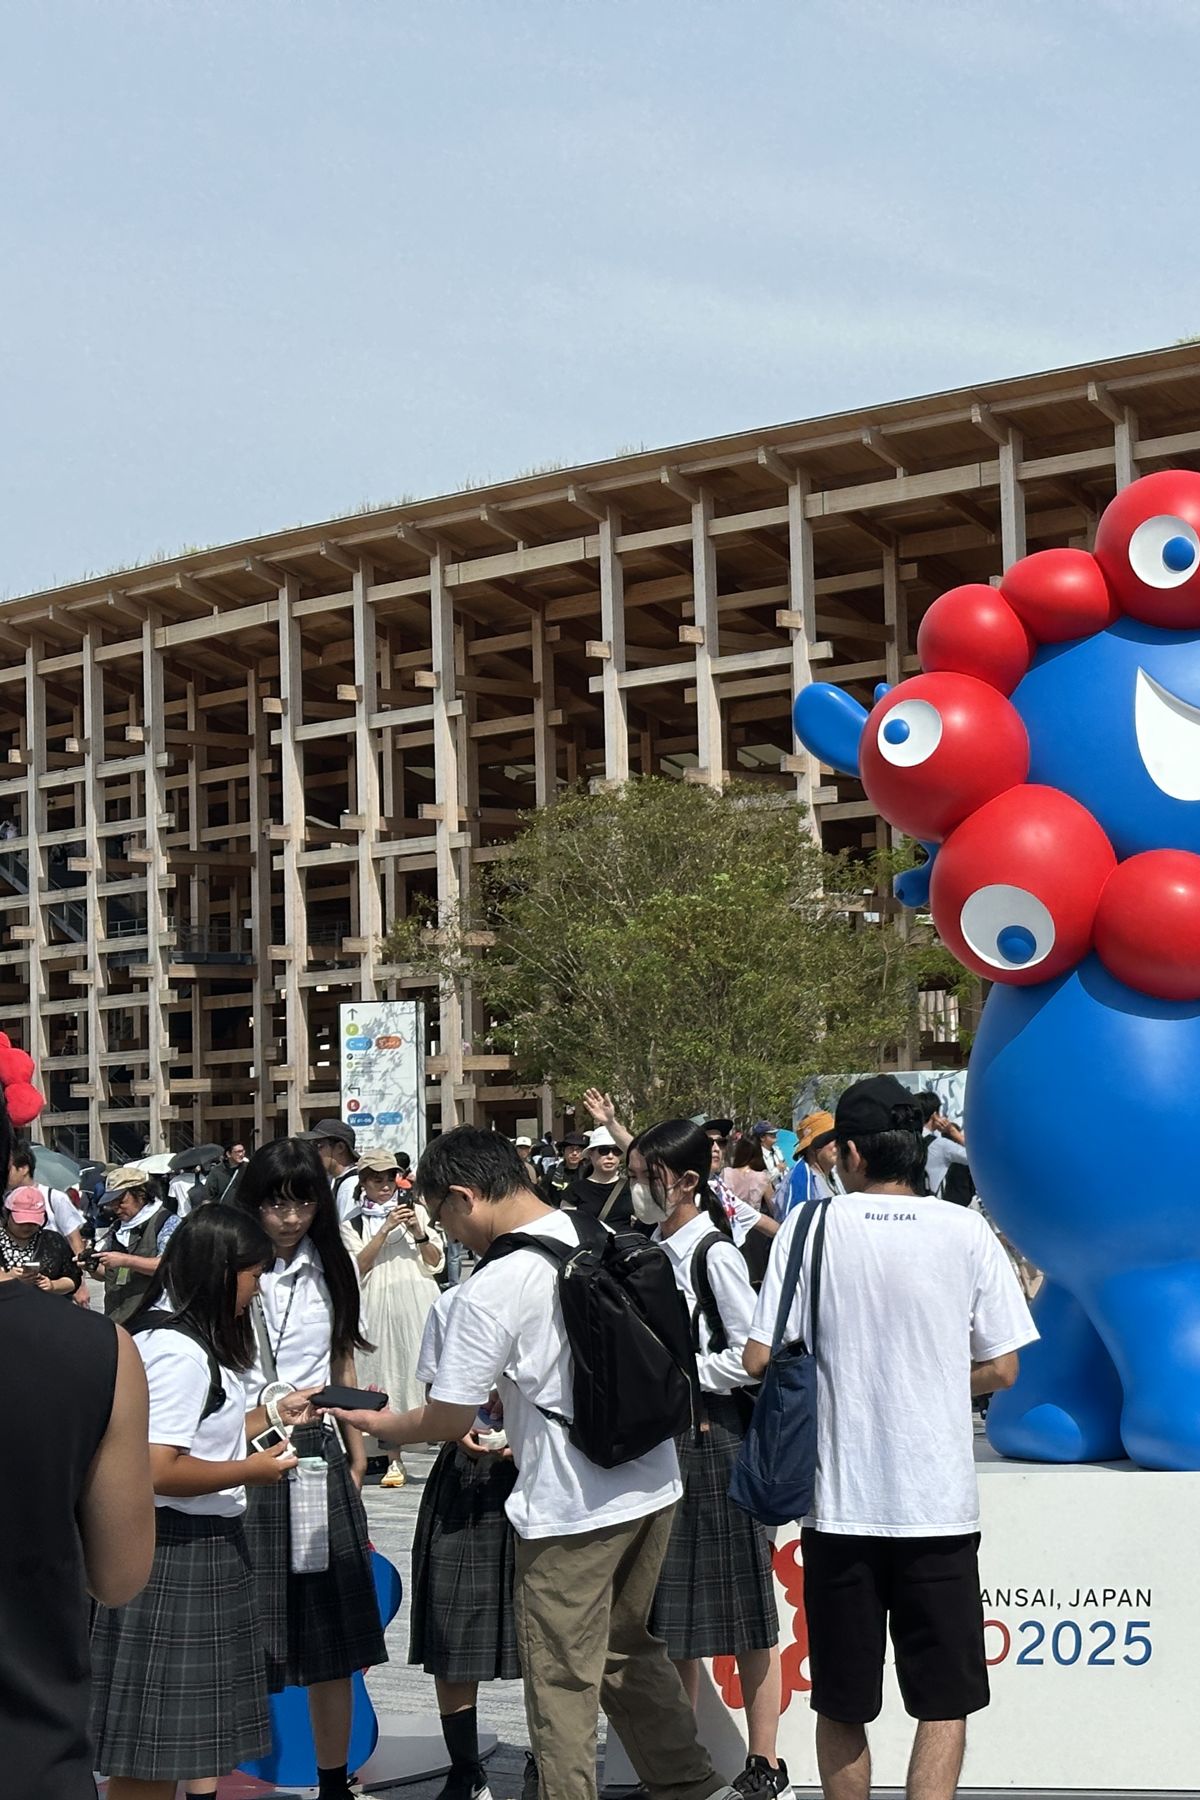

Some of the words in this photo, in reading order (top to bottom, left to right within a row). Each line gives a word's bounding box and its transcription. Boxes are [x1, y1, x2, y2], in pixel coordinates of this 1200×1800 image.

[864, 1212, 890, 1221] BLUE
[892, 1213, 918, 1221] SEAL
[979, 1587, 1062, 1611] ANSAI,
[1067, 1587, 1152, 1608] JAPAN
[983, 1618, 1153, 1667] O2025
